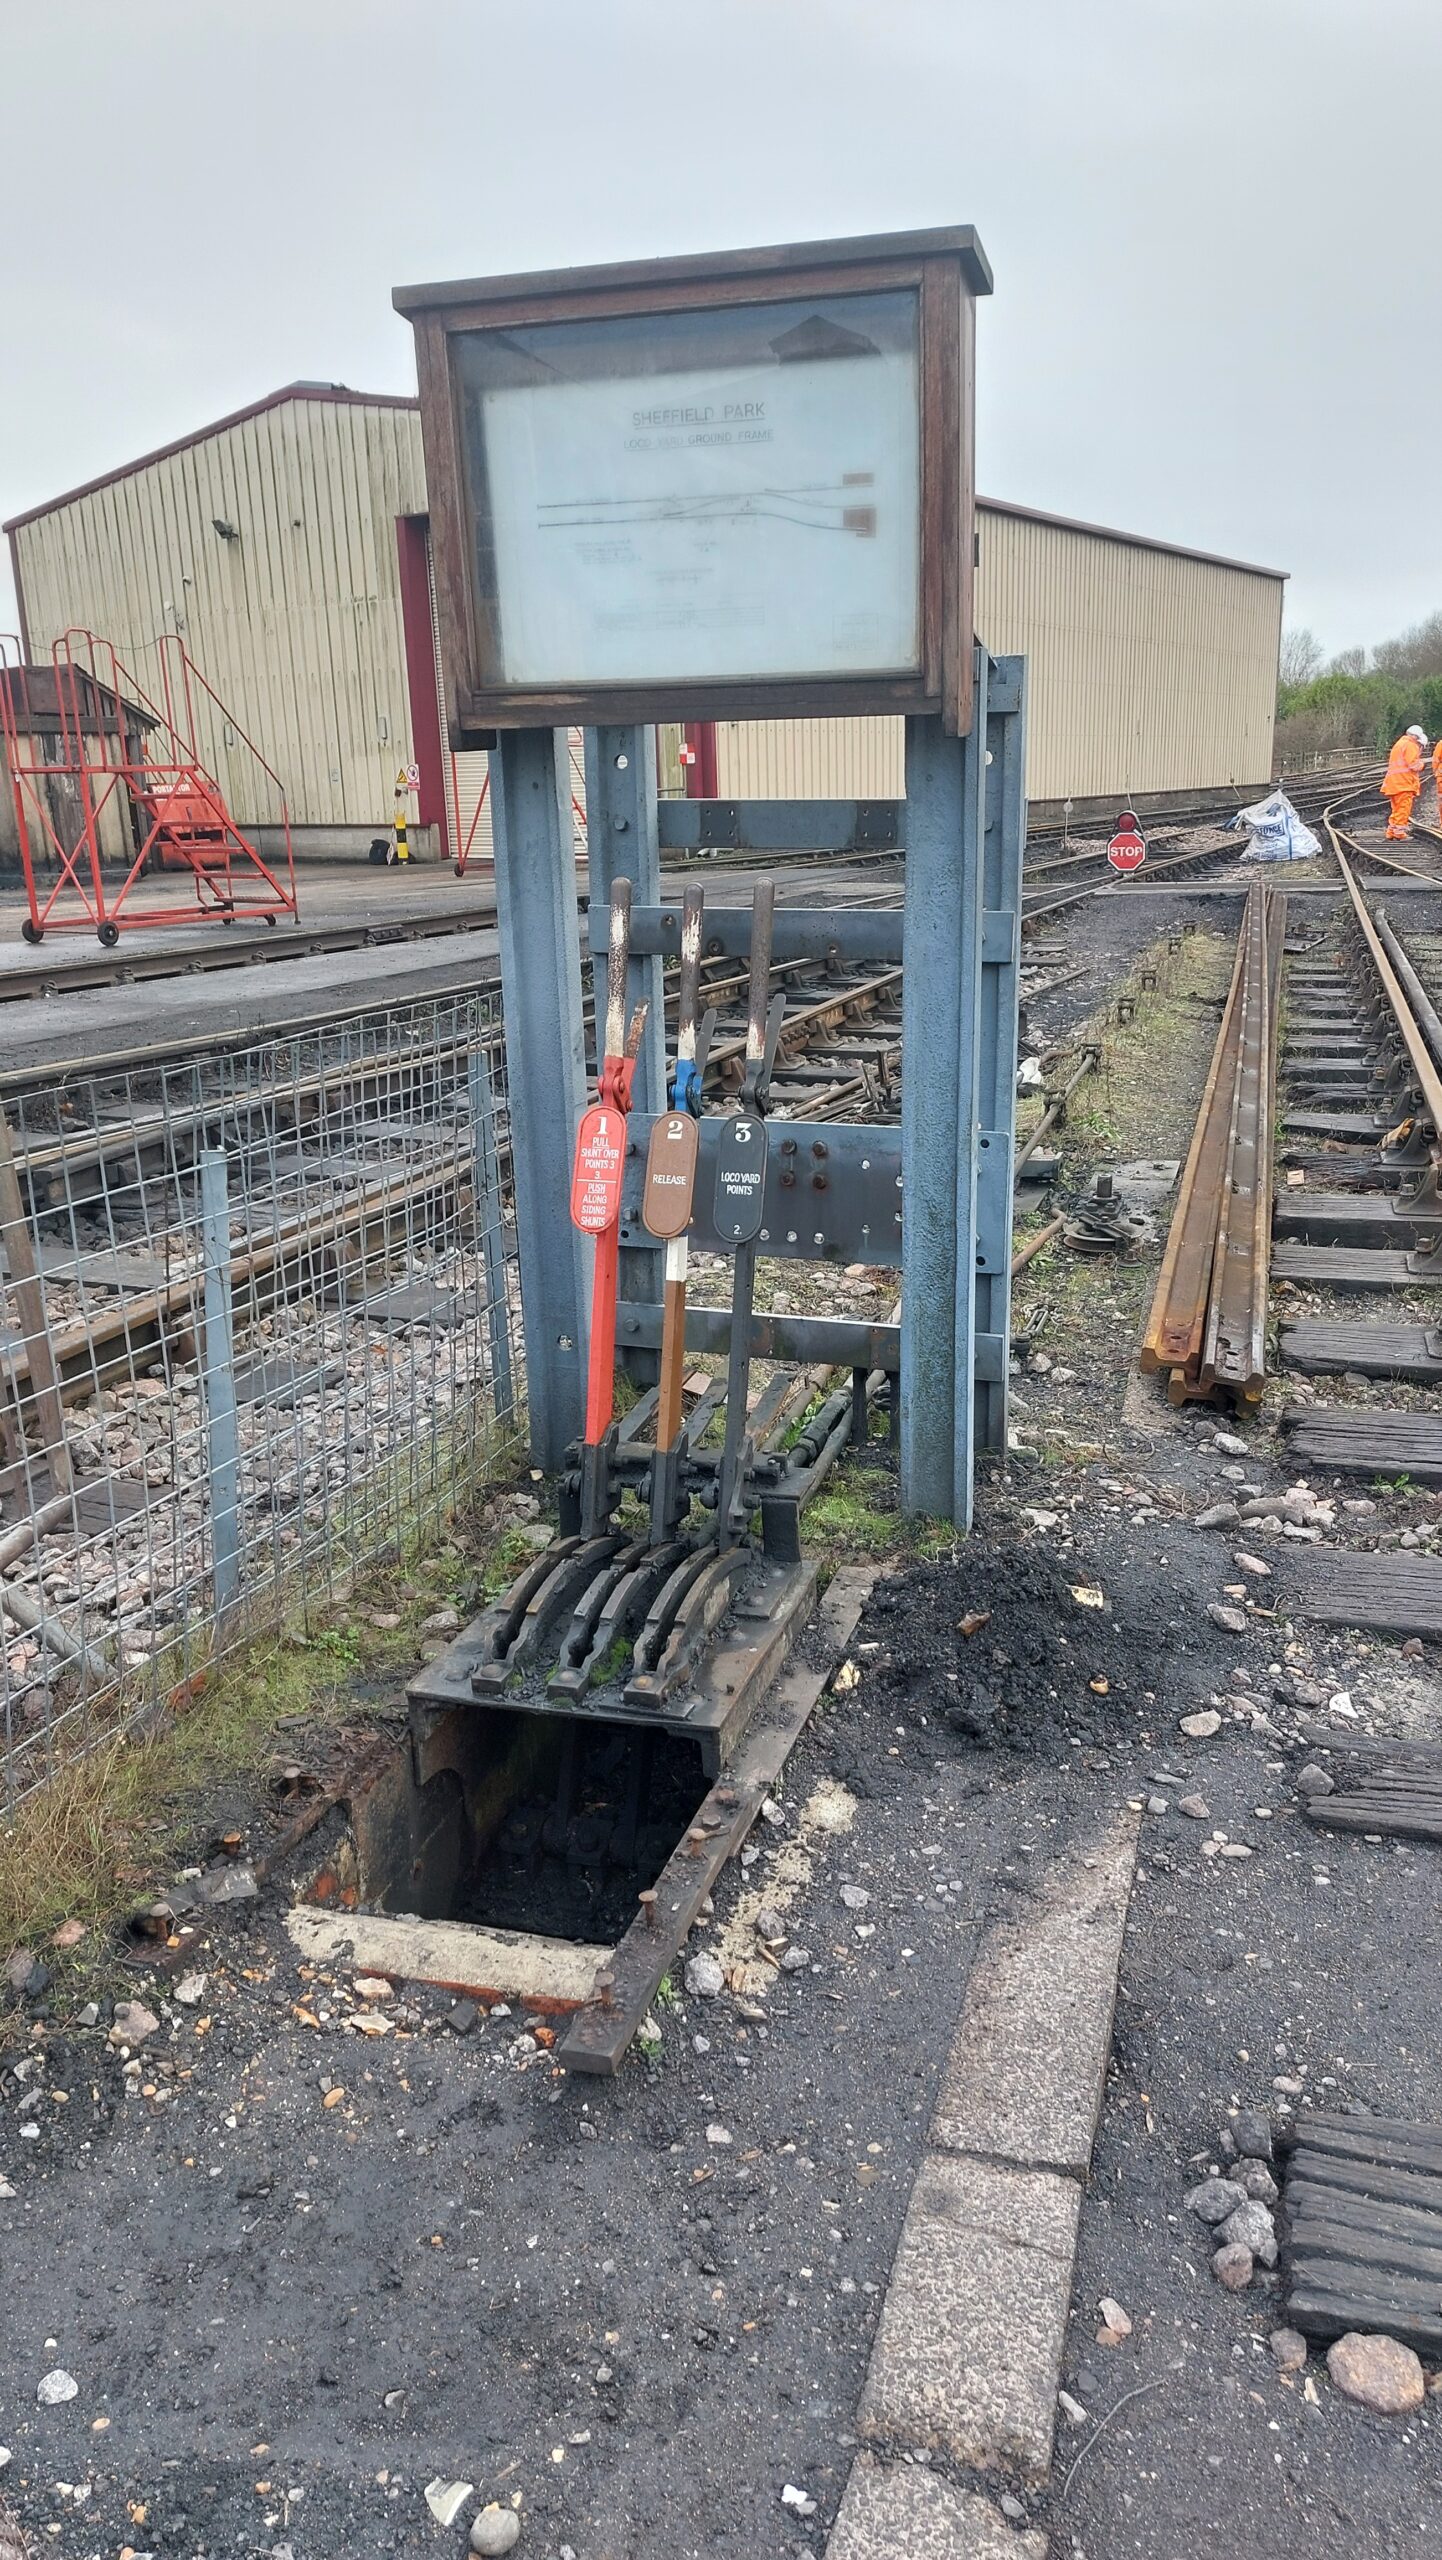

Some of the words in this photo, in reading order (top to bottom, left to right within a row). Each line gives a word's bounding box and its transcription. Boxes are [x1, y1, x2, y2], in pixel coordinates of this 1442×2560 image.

[632, 406, 714, 427] SHEFFIELD
[723, 402, 766, 419] PARK
[687, 431, 732, 445] GROUND
[737, 428, 774, 441] FRAME
[1110, 846, 1143, 857] STOP
[596, 1116, 608, 1135] 1
[667, 1120, 684, 1140] 2
[735, 1122, 753, 1143] 3
[592, 1136, 609, 1147] PULL
[580, 1147, 602, 1158] SHUNT
[603, 1149, 620, 1159] OVER
[584, 1158, 609, 1169] POINTS
[609, 1160, 616, 1169] 3
[652, 1173, 687, 1186] RELEASE
[720, 1171, 740, 1183] LOCO
[740, 1172, 761, 1184] YARD
[587, 1183, 606, 1193] PUSH
[726, 1184, 753, 1196] POINTS
[582, 1194, 608, 1204] ALONG
[581, 1204, 607, 1215] SIDING
[580, 1215, 606, 1227] SHUNTS
